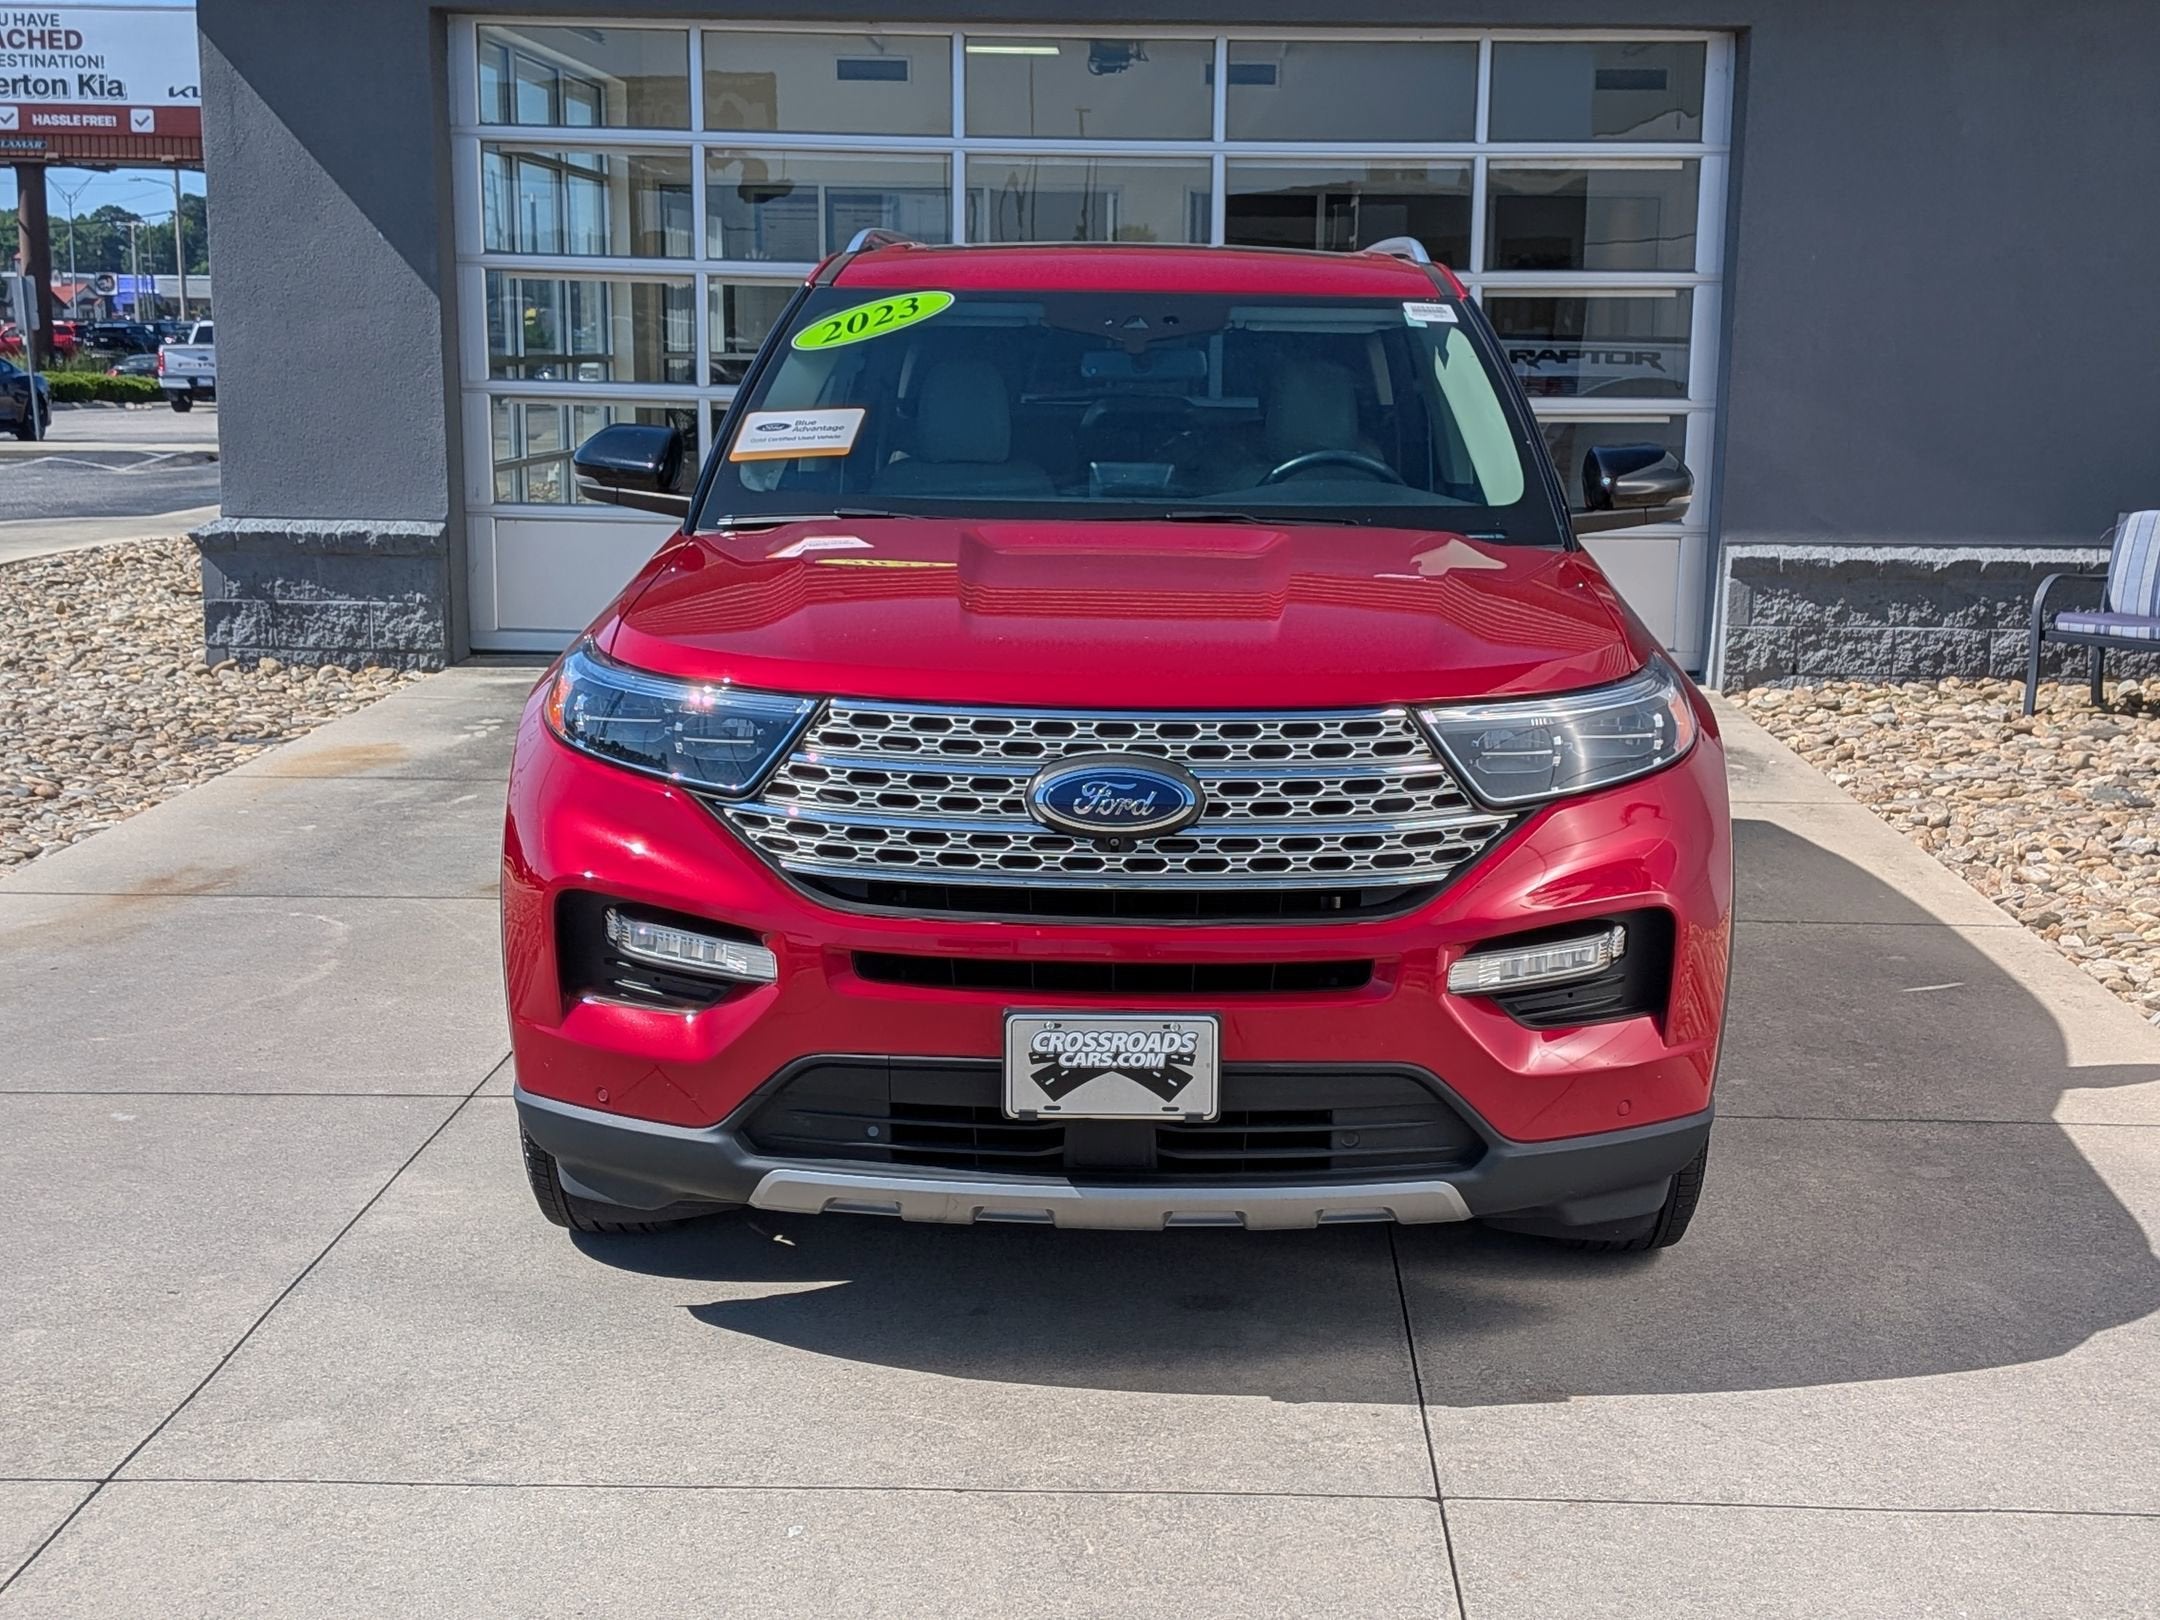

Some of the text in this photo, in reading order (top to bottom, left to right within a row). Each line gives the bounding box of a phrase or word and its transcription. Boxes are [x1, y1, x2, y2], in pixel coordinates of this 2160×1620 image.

[14, 13, 60, 27] HAVE
[78, 74, 125, 98] Kia
[32, 114, 117, 127] HASSLE FREE!
[821, 297, 920, 344] 2023
[1509, 349, 1666, 373] RAPTOR
[792, 425, 845, 433] Advantage
[1073, 781, 1158, 817] Ford
[1031, 1031, 1198, 1054] CROSSROADS
[1058, 1051, 1167, 1069] CARS.COM
